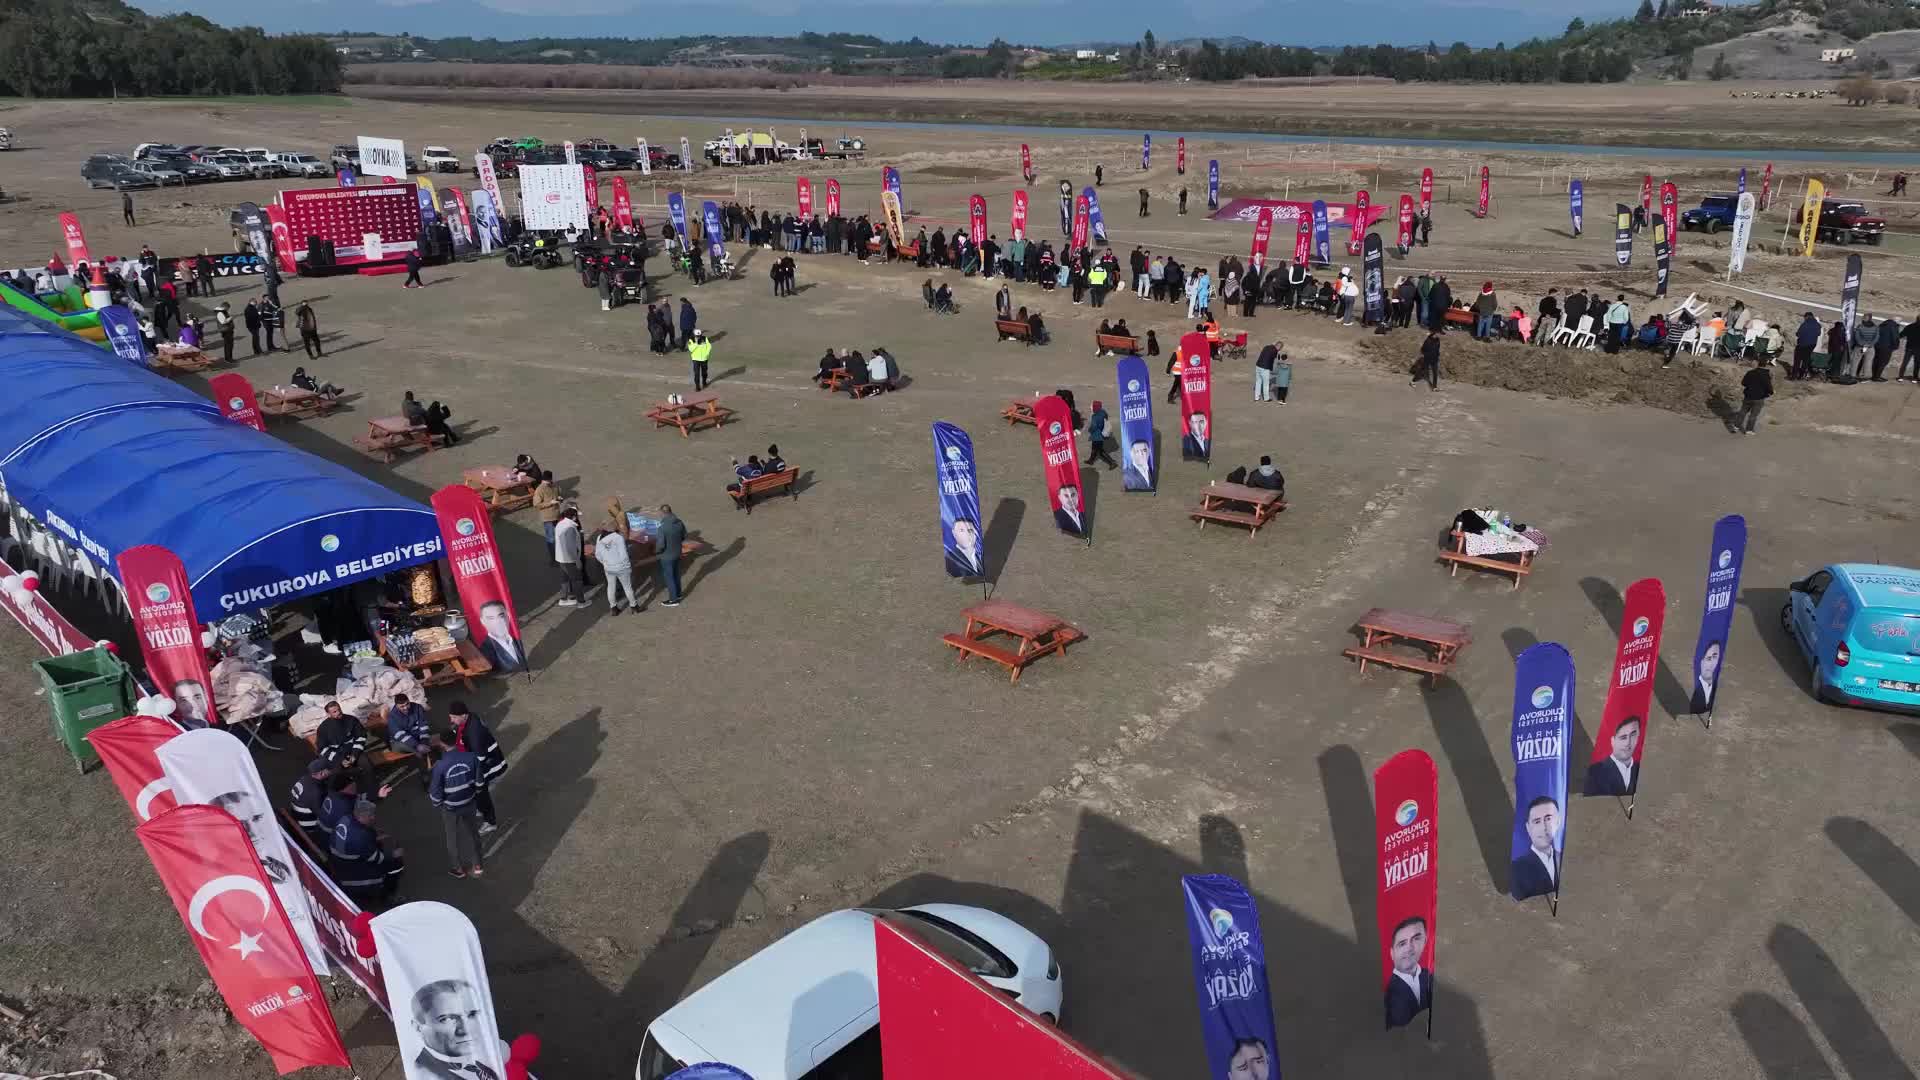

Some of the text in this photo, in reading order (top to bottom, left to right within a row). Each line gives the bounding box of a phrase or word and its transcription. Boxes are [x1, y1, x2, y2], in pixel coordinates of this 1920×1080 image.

[372, 147, 391, 167] OYNA
[173, 264, 266, 280] SVICE
[219, 535, 442, 612] ÇUKUROVA BELEDİYESİ
